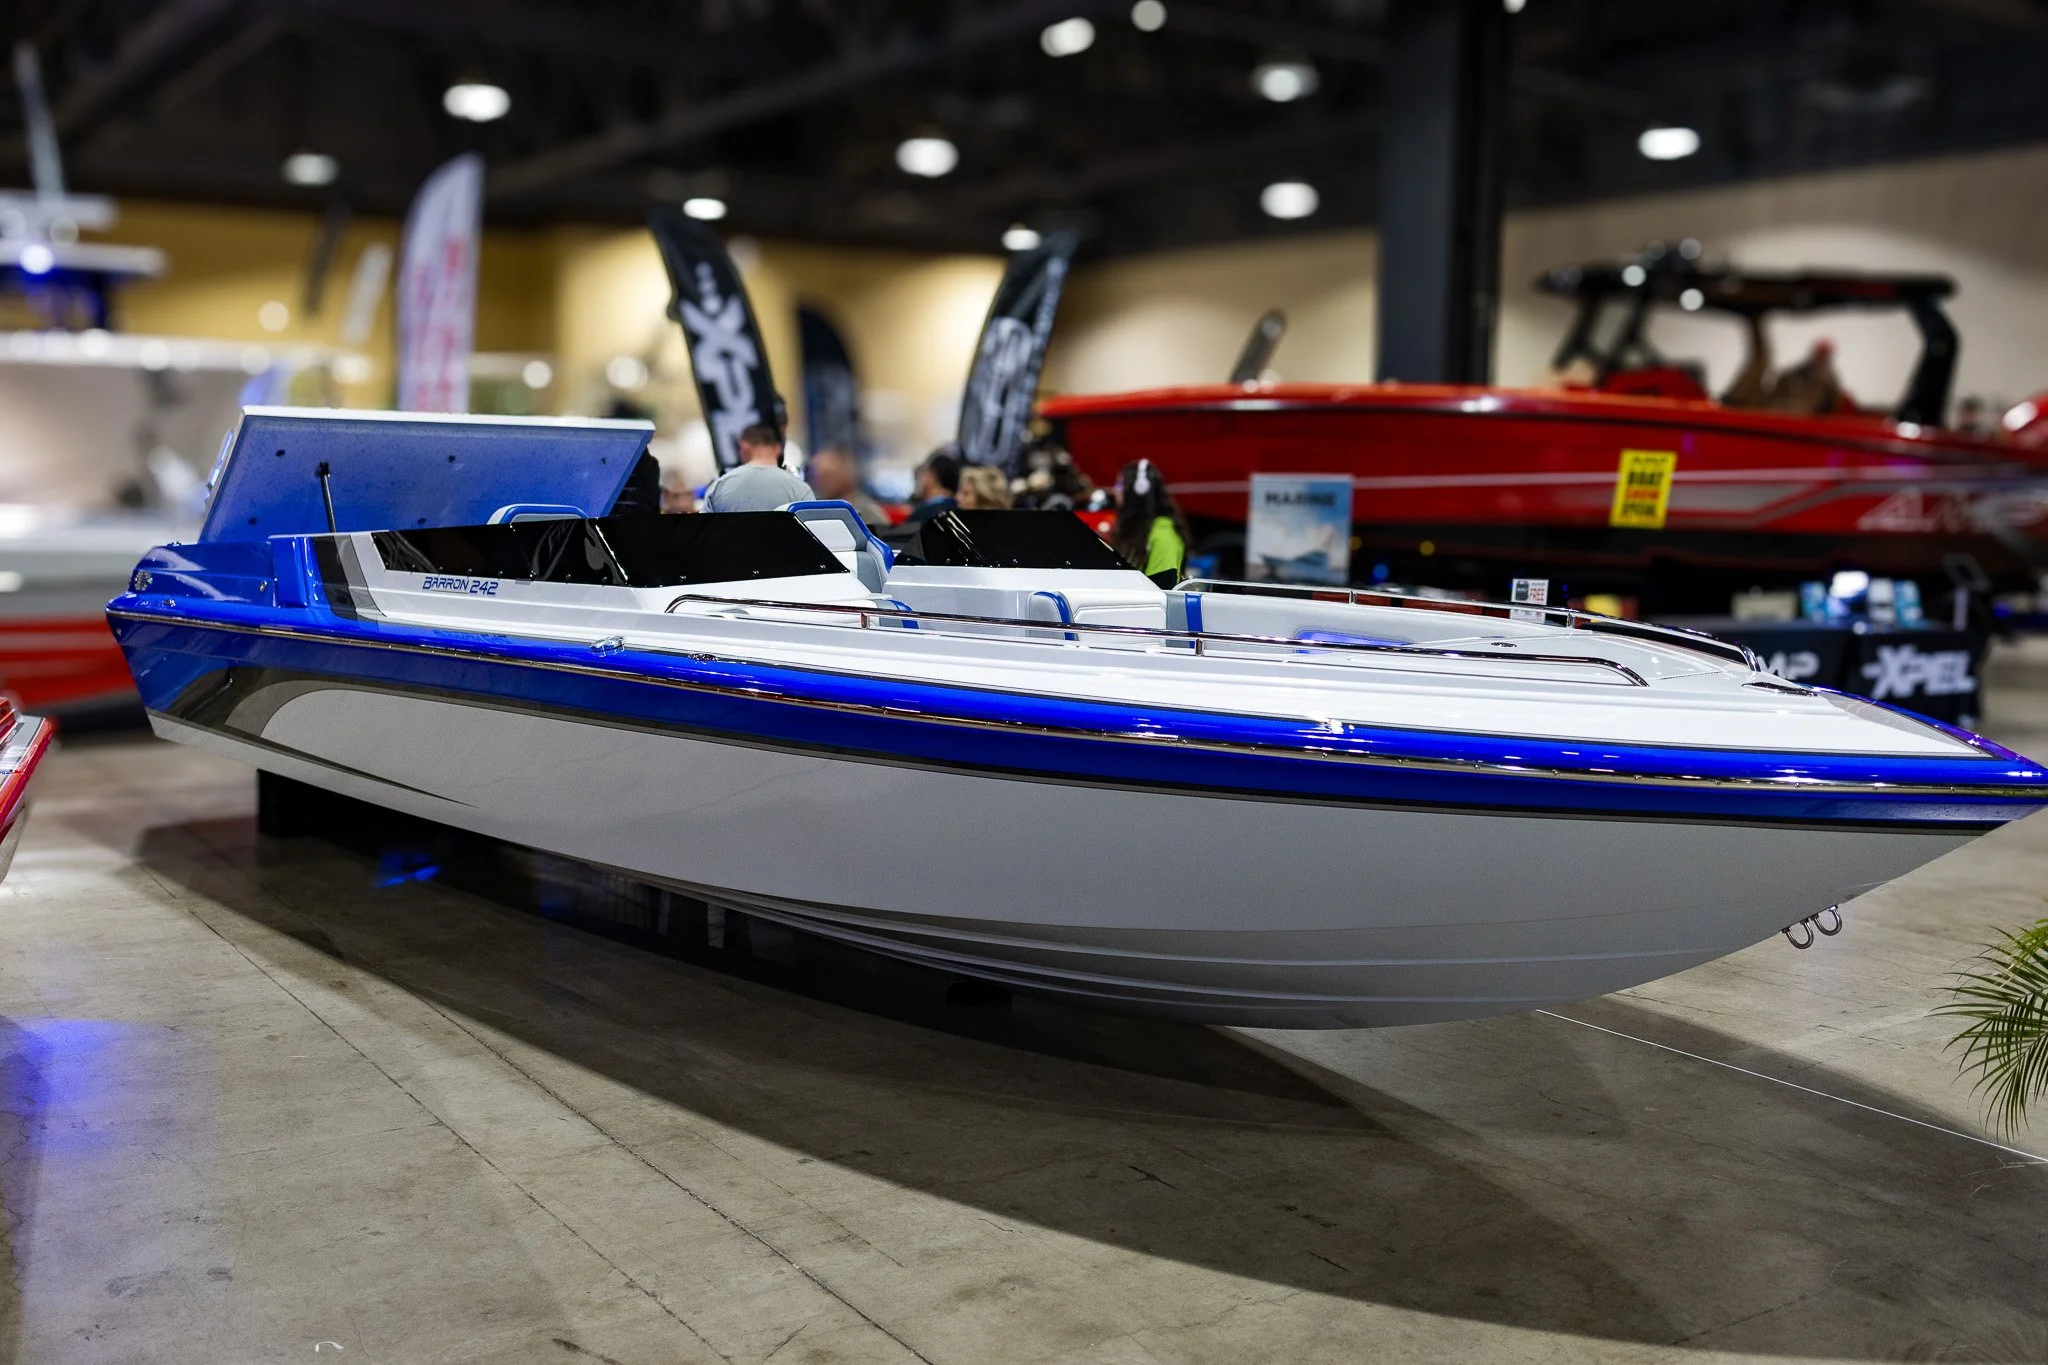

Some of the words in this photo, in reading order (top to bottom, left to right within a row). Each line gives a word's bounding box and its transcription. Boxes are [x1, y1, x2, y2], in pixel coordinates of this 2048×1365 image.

[1264, 491, 1336, 507] MARINE
[422, 576, 469, 590] BARRON
[469, 580, 499, 596] 242
[1870, 644, 1977, 699] XPEL
